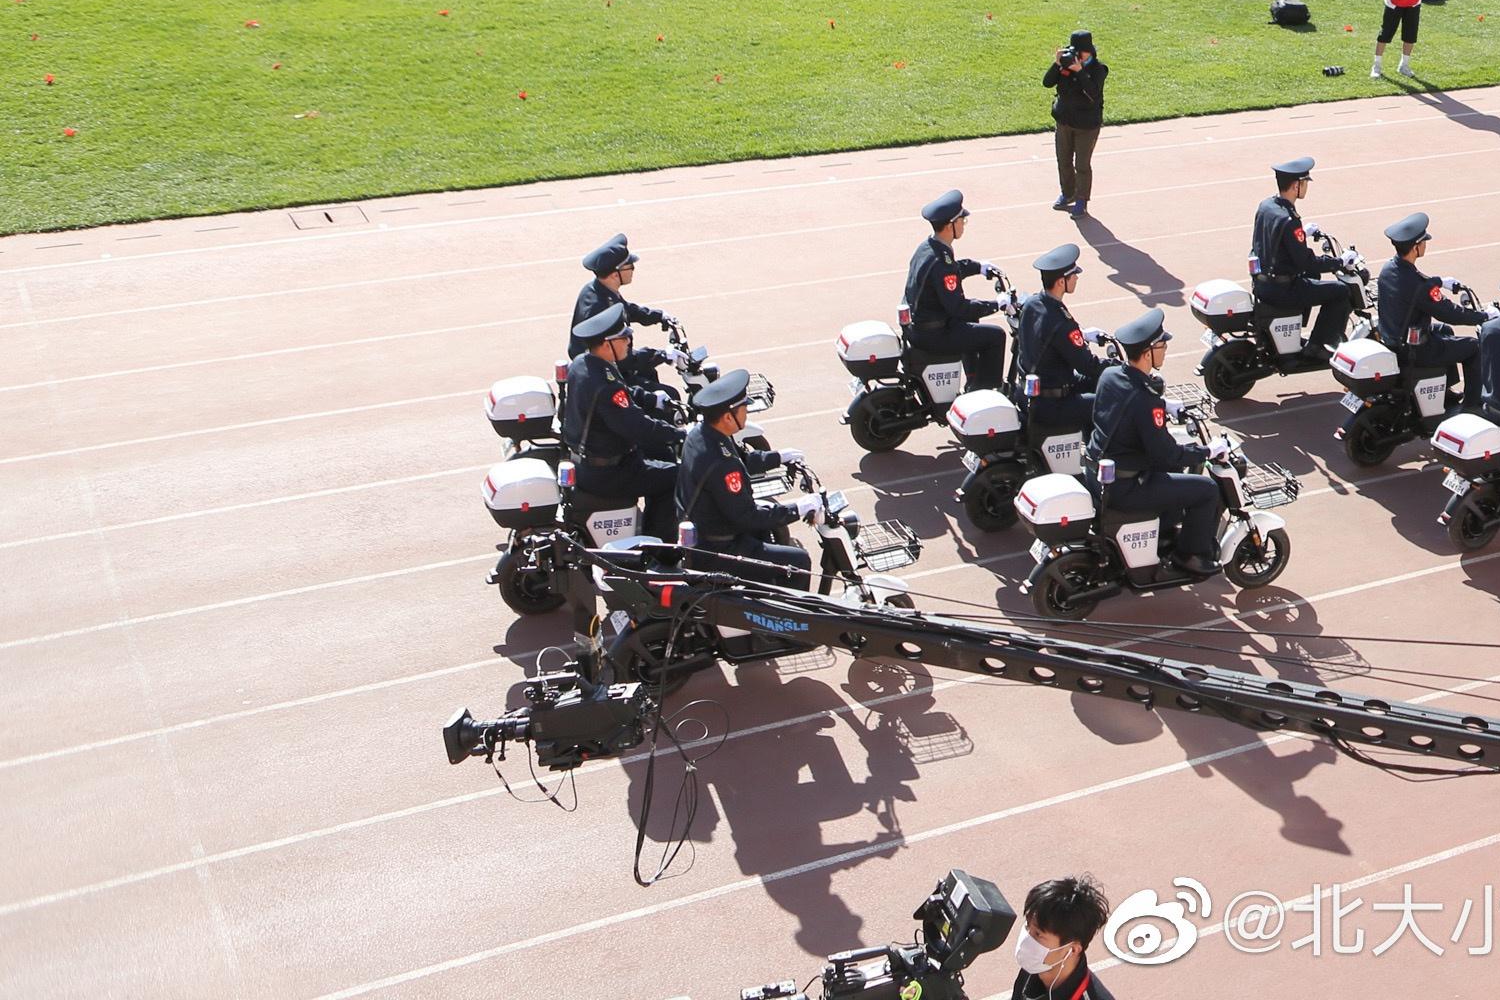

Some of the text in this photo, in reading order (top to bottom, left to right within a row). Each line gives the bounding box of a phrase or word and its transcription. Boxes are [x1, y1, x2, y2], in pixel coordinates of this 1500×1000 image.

[606, 528, 619, 536] 06
[1131, 541, 1148, 549] 013
[743, 611, 809, 632] TRIANGLE
